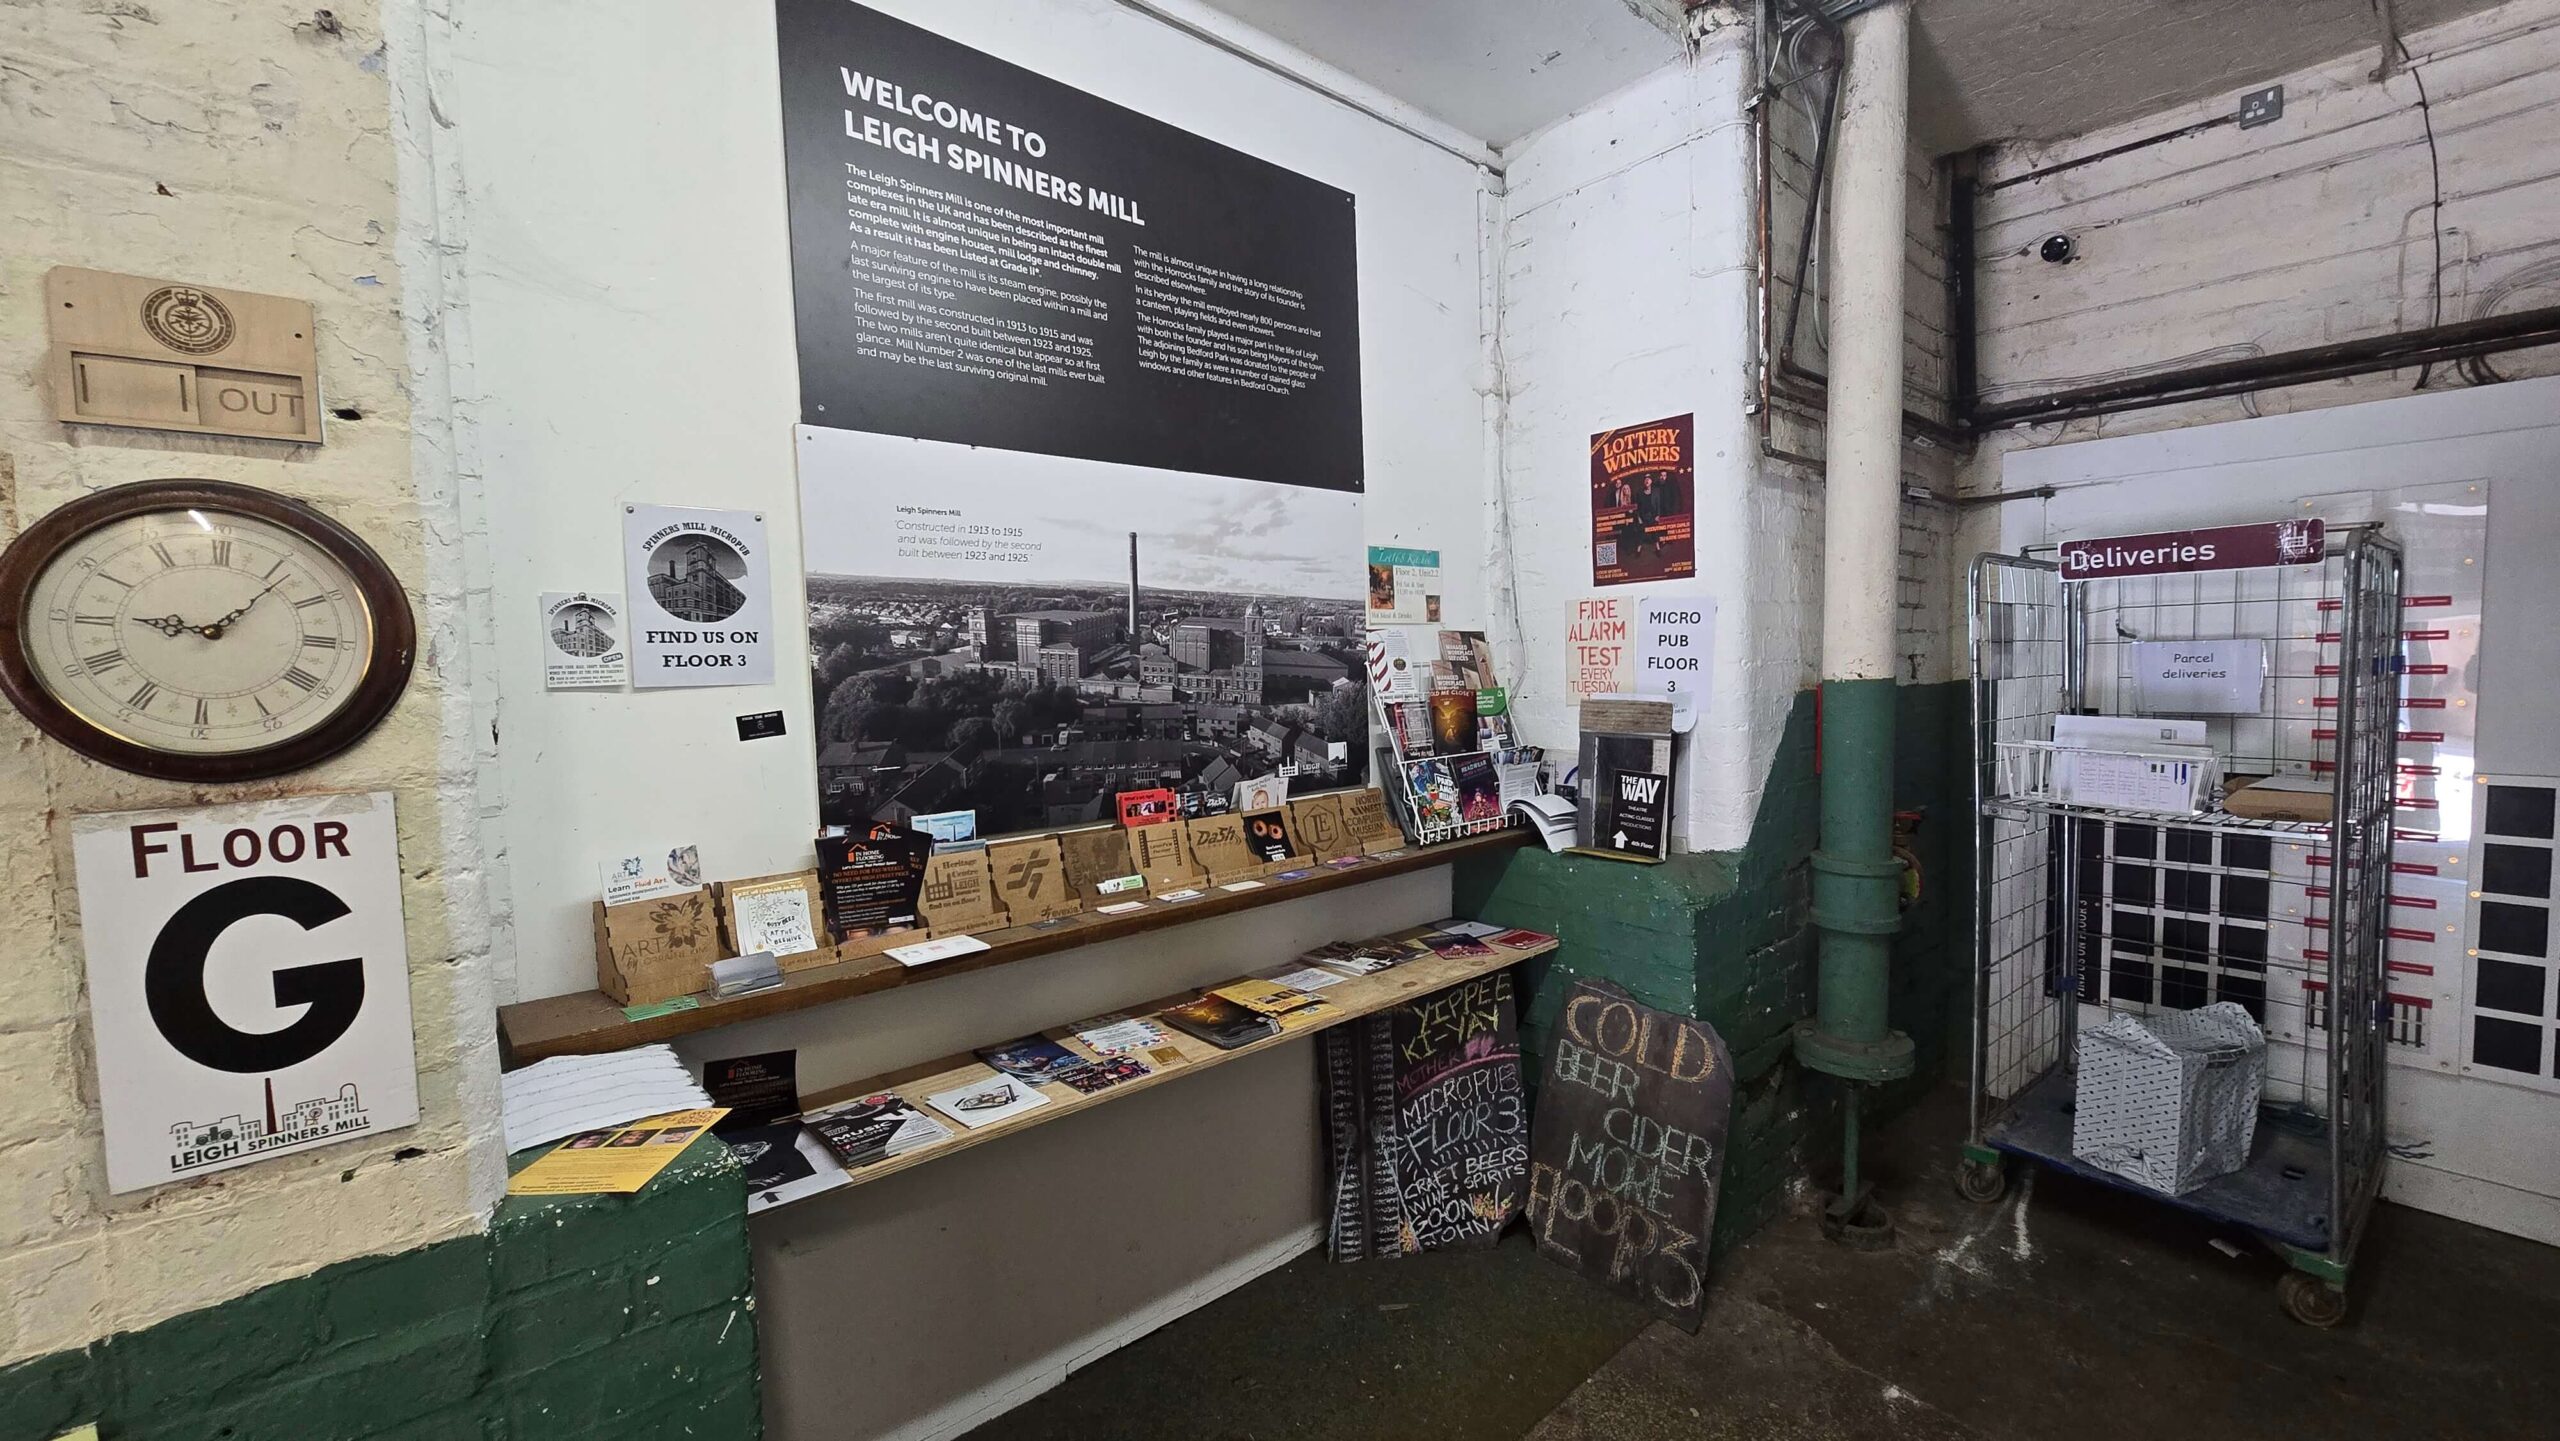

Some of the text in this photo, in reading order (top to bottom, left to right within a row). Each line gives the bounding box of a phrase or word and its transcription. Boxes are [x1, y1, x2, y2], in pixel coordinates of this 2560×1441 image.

[840, 66, 1047, 158] WELCOME TO
[844, 109, 1145, 226] LEIGH SPINNERS MILL
[844, 162, 1105, 245] The Leigh Spinners Mill is one of the most important mill
[846, 179, 1108, 257] complexes in the UK and has been described as the finest
[218, 388, 304, 418] OUT
[1602, 428, 1680, 460] LOTTERY
[1602, 446, 1681, 474] WINNERS
[896, 505, 961, 517] Leigh Spinners Mill
[642, 521, 750, 557] SPINNERS MILL MICROPUB
[957, 525, 966, 534] in
[968, 525, 989, 536] 1913
[991, 526, 1001, 537] to
[1003, 527, 1023, 538] 1915
[897, 534, 1042, 551] and was followed by the second
[898, 547, 919, 558] built
[921, 548, 962, 559] between
[965, 550, 986, 561] 1923
[988, 552, 1005, 562] and
[2069, 541, 2217, 571] Deliveries
[1579, 599, 1618, 620] FIRE
[1649, 611, 1702, 625] MICRO
[646, 631, 759, 644] FIND US ON
[1568, 620, 1626, 642] ALARM
[1445, 643, 1468, 651] MANAGED
[1658, 634, 1689, 647] PUB
[1447, 649, 1474, 657] WORKPLACE
[1577, 646, 1622, 666] TEST
[2173, 652, 2214, 664] Parcel
[662, 654, 747, 668] FLOOR 3
[1648, 656, 1699, 671] FLOOR
[1580, 668, 1614, 680] EVERY
[2162, 668, 2227, 680] deliveries
[1437, 679, 1465, 688] WORKPLACE
[1570, 680, 1620, 694] TUESDAY
[1667, 680, 1676, 693] 3
[1620, 774, 1639, 785] THE
[1355, 793, 1382, 804] NORTH
[1621, 777, 1661, 805] WAY
[1362, 803, 1384, 813] WEST
[1628, 805, 1648, 813] THEATRE
[1345, 813, 1385, 827] COMPUTER
[1620, 821, 1652, 831] PRODUCTIONS
[1635, 815, 1655, 823] CLASSES
[1351, 823, 1385, 836] MUSEUM
[130, 820, 352, 879] FLOOR
[1640, 842, 1655, 850] Floor
[855, 854, 885, 862] FLOORING
[942, 858, 978, 870] Heritage
[611, 870, 627, 881] ART
[952, 869, 979, 879] Centre
[607, 876, 668, 894] Learn Fluid Art
[954, 878, 980, 891] LEIGH
[766, 914, 796, 928] BUSY BEES
[769, 927, 793, 937] AT THE
[773, 933, 803, 946] BEEHIVE
[621, 935, 667, 961] ART
[144, 875, 366, 1074] G
[1412, 973, 1513, 1033] YIPPEE
[1401, 1004, 1499, 1065] KI-YAY
[1566, 995, 1715, 1083] COLD
[1396, 1049, 1461, 1094] MOTHER
[1554, 1038, 1641, 1108] BEER
[1402, 1063, 1520, 1130] MICROPUB
[832, 1120, 893, 1142] MUSIC
[1404, 1096, 1522, 1166] FLOOR 3
[170, 1115, 371, 1170] LEIGH SPINNERS MILL
[1603, 1107, 1713, 1188] CIDER
[1404, 1143, 1528, 1200] CRAFT BEERS
[1566, 1130, 1681, 1219] MORE
[1408, 1163, 1526, 1216] WINE SPIRITS
[1525, 1161, 1701, 1308] FLOOR 3
